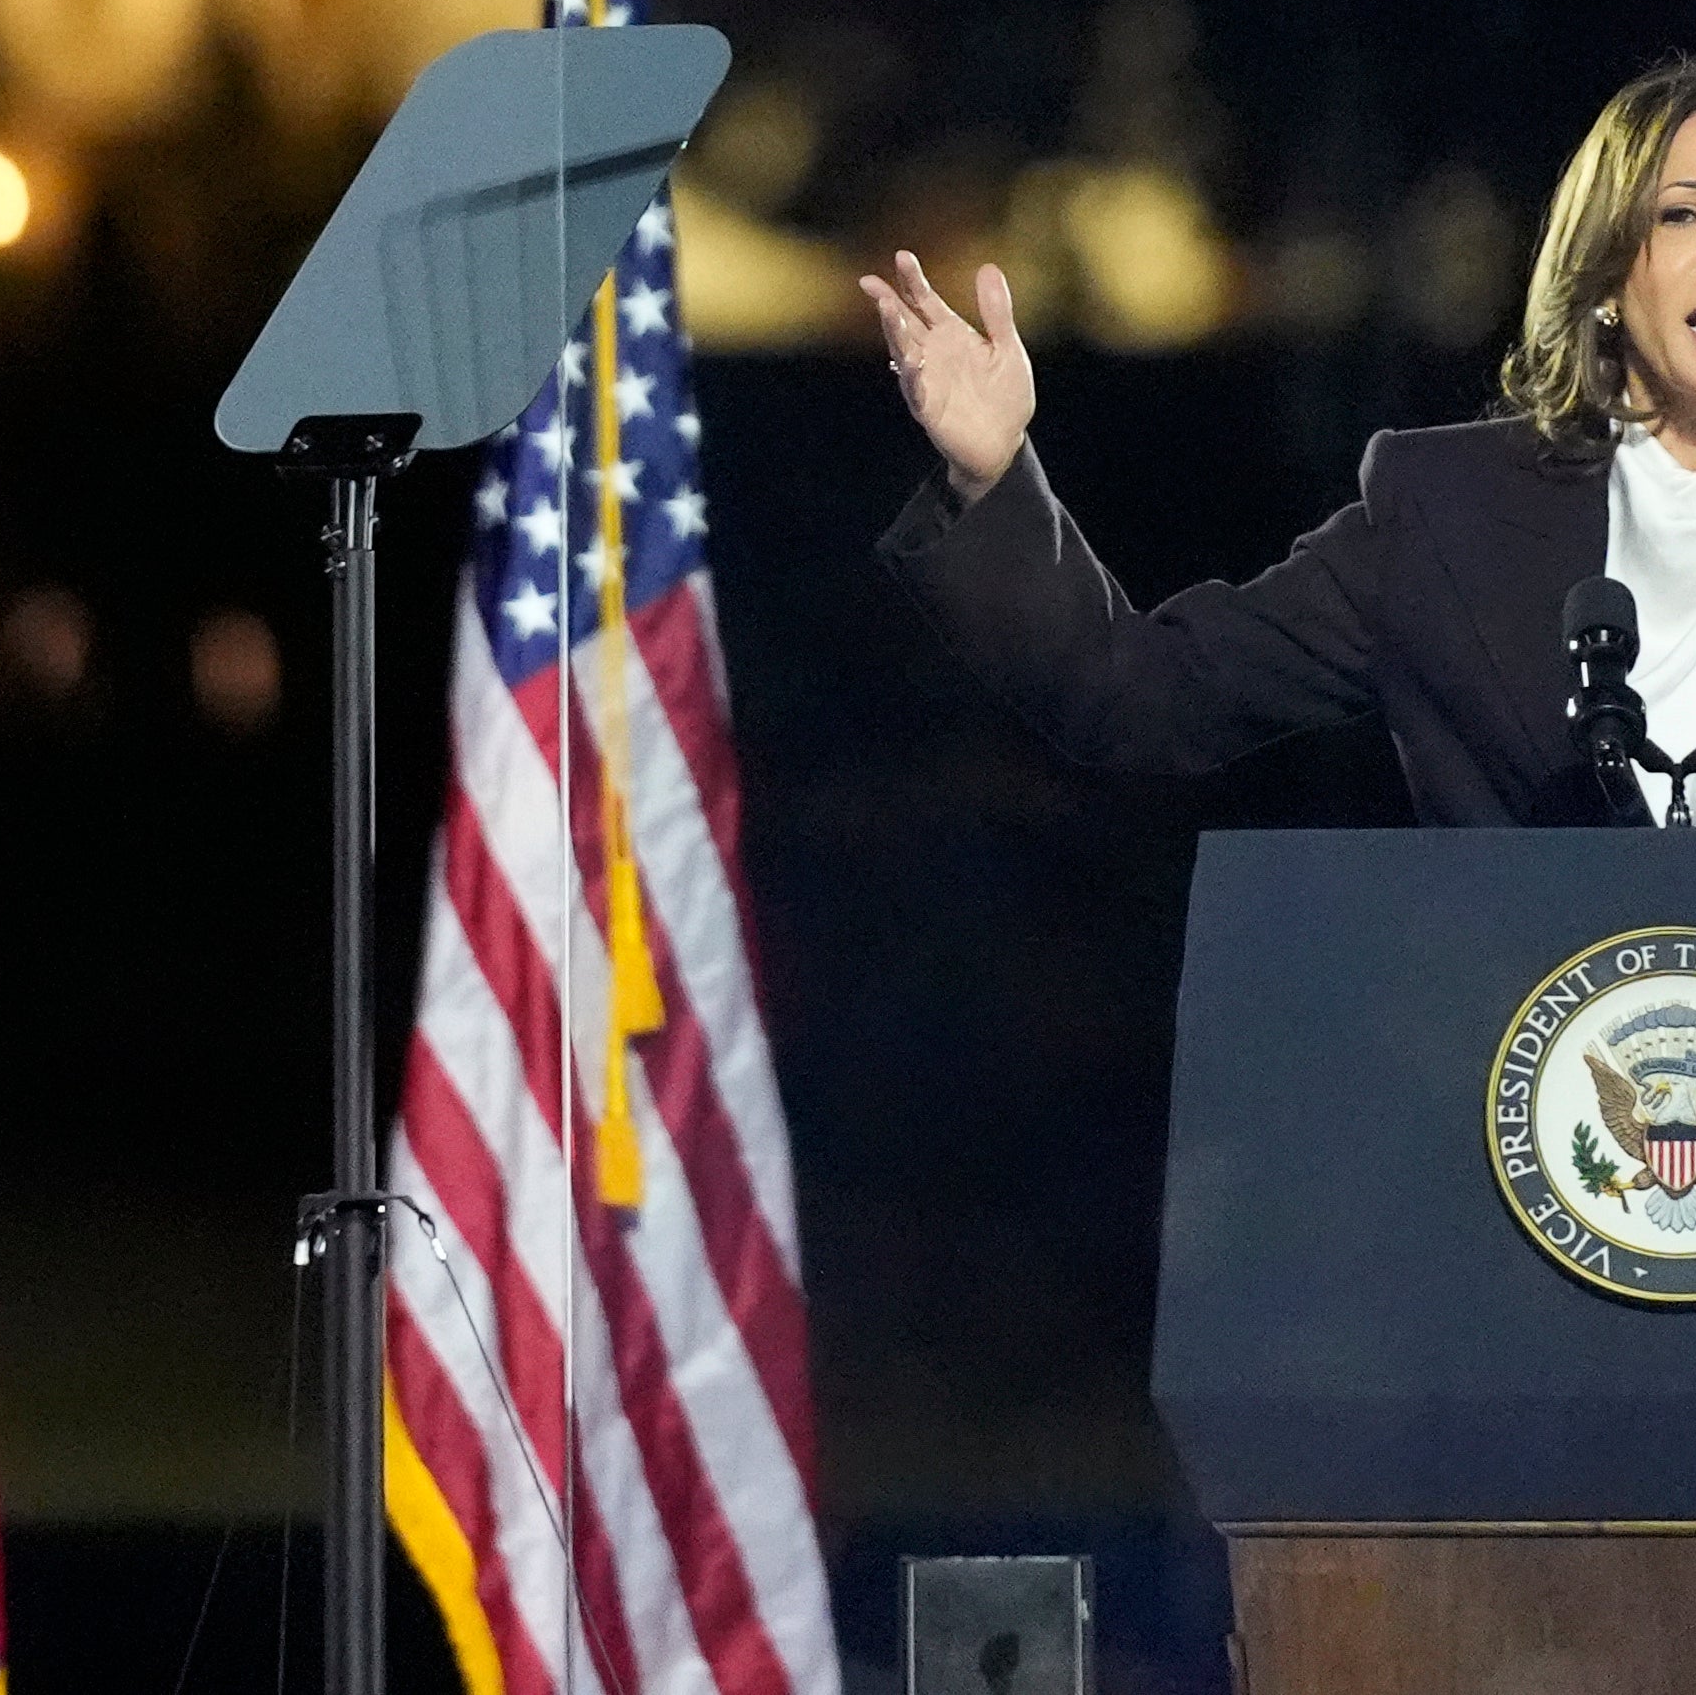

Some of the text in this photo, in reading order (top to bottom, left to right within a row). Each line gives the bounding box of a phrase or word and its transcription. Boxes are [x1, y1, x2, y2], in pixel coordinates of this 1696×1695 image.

[1616, 945, 1656, 975] OF
[1497, 962, 1596, 1180] PRESIDENT
[1528, 1193, 1611, 1277] VICE
